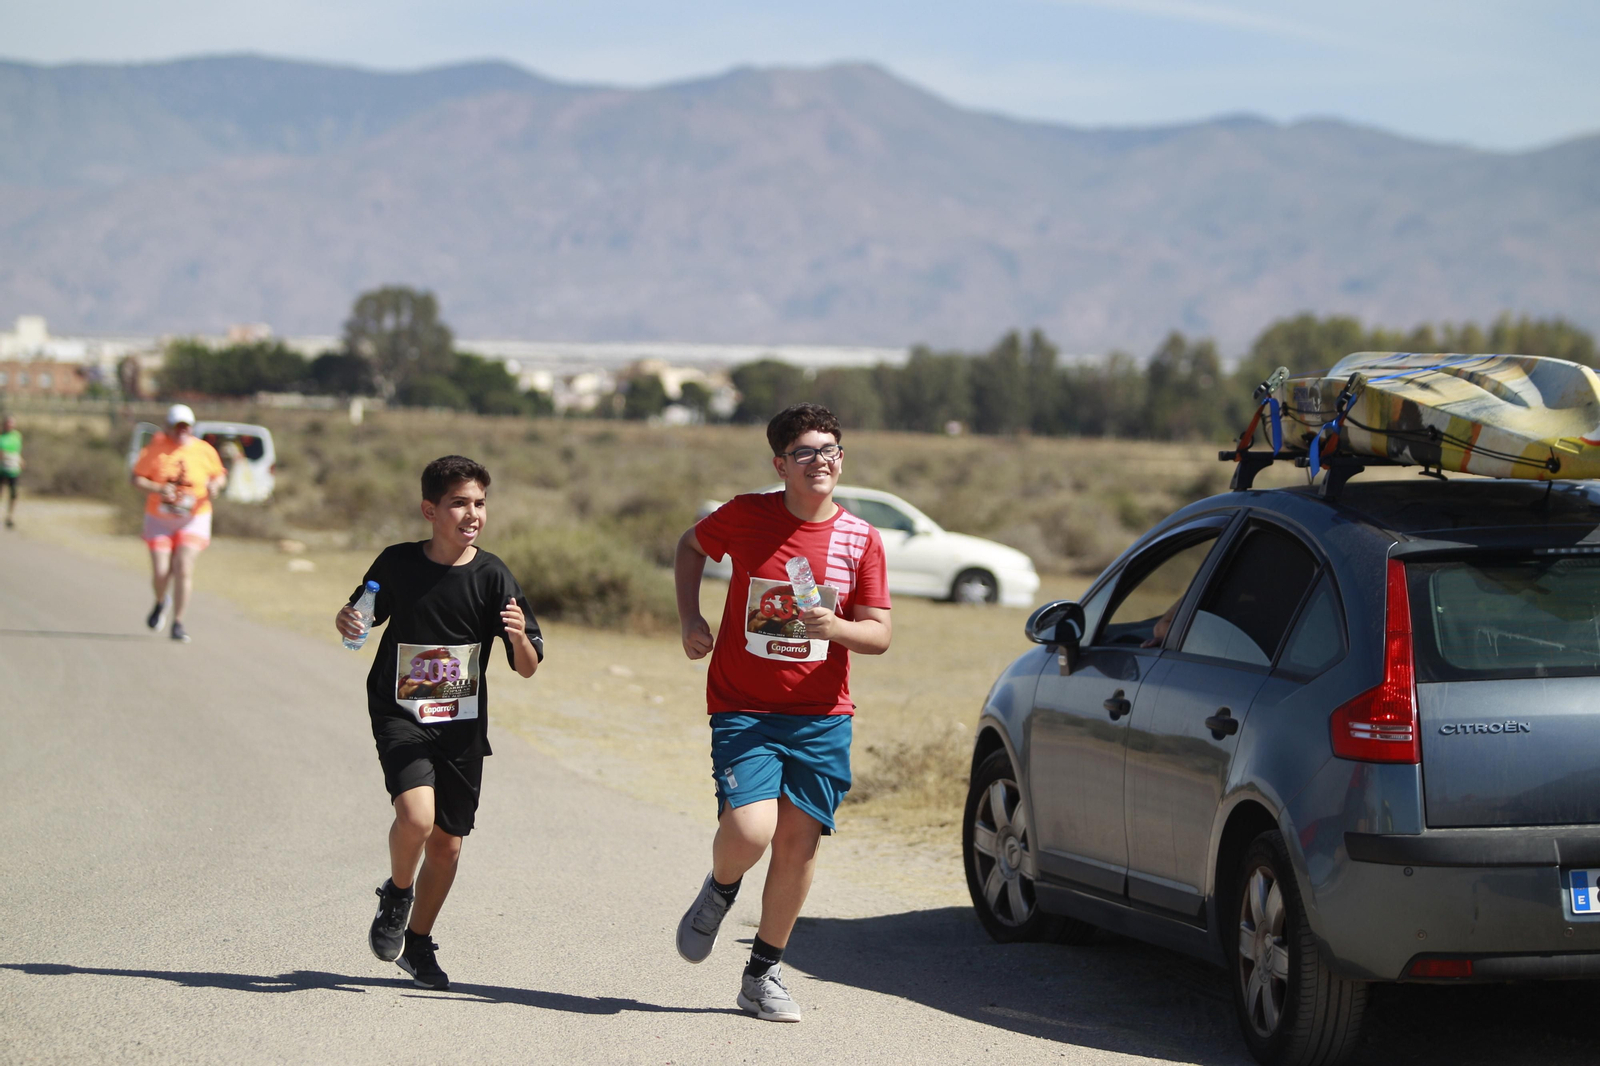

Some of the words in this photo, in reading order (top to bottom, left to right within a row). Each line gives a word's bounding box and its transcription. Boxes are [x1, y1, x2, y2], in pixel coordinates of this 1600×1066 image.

[410, 657, 461, 683] 806
[1438, 720, 1531, 735] CITROËN
[1577, 895, 1586, 905] E
